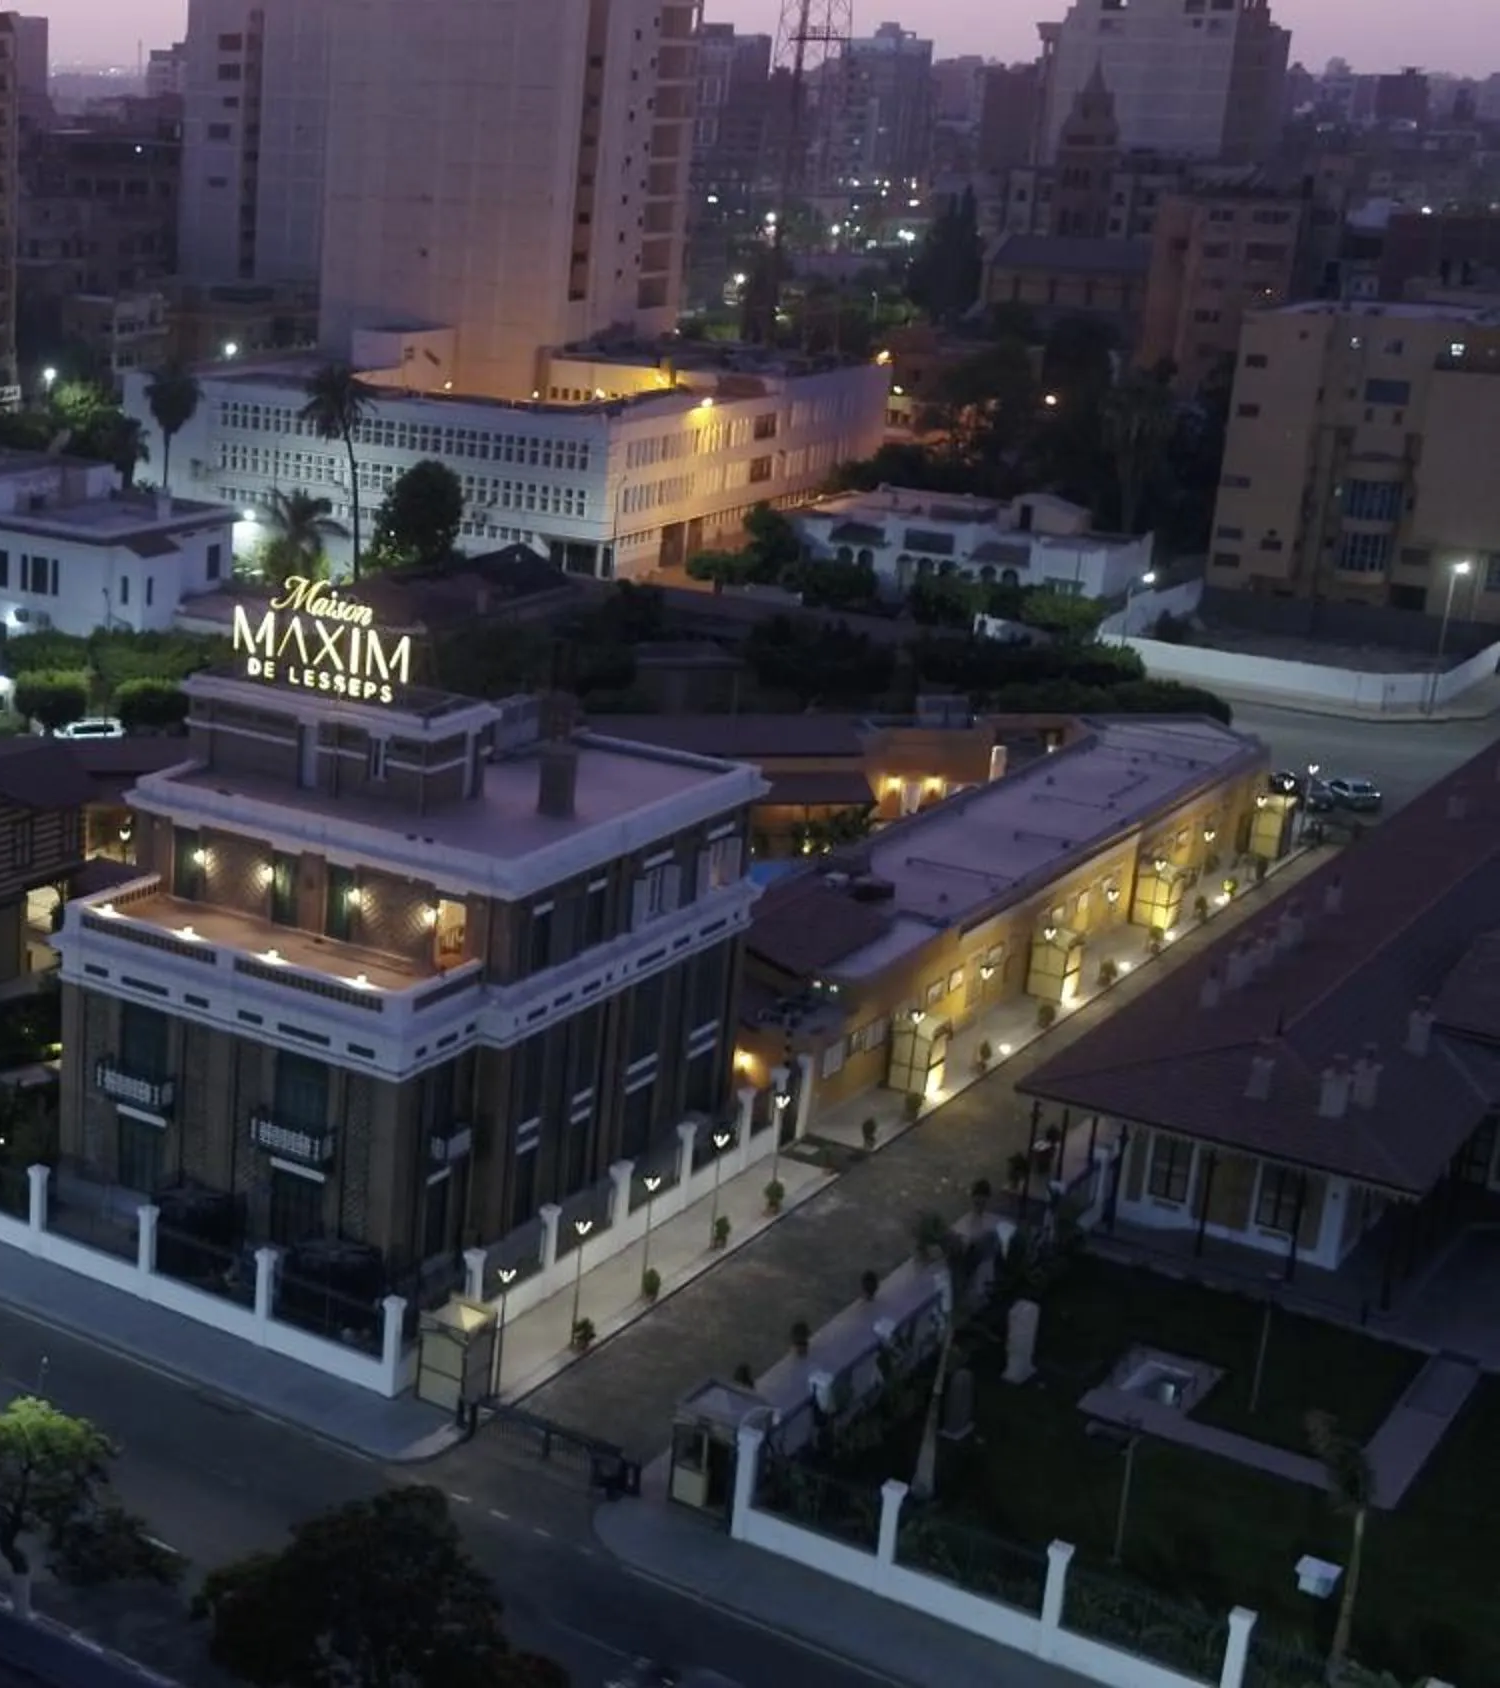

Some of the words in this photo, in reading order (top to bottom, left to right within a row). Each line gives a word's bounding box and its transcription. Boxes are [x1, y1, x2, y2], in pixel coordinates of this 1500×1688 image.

[271, 575, 373, 626] Maison
[233, 604, 411, 684] MAXIM
[247, 656, 275, 679] DE
[288, 665, 393, 704] LESSEPS
